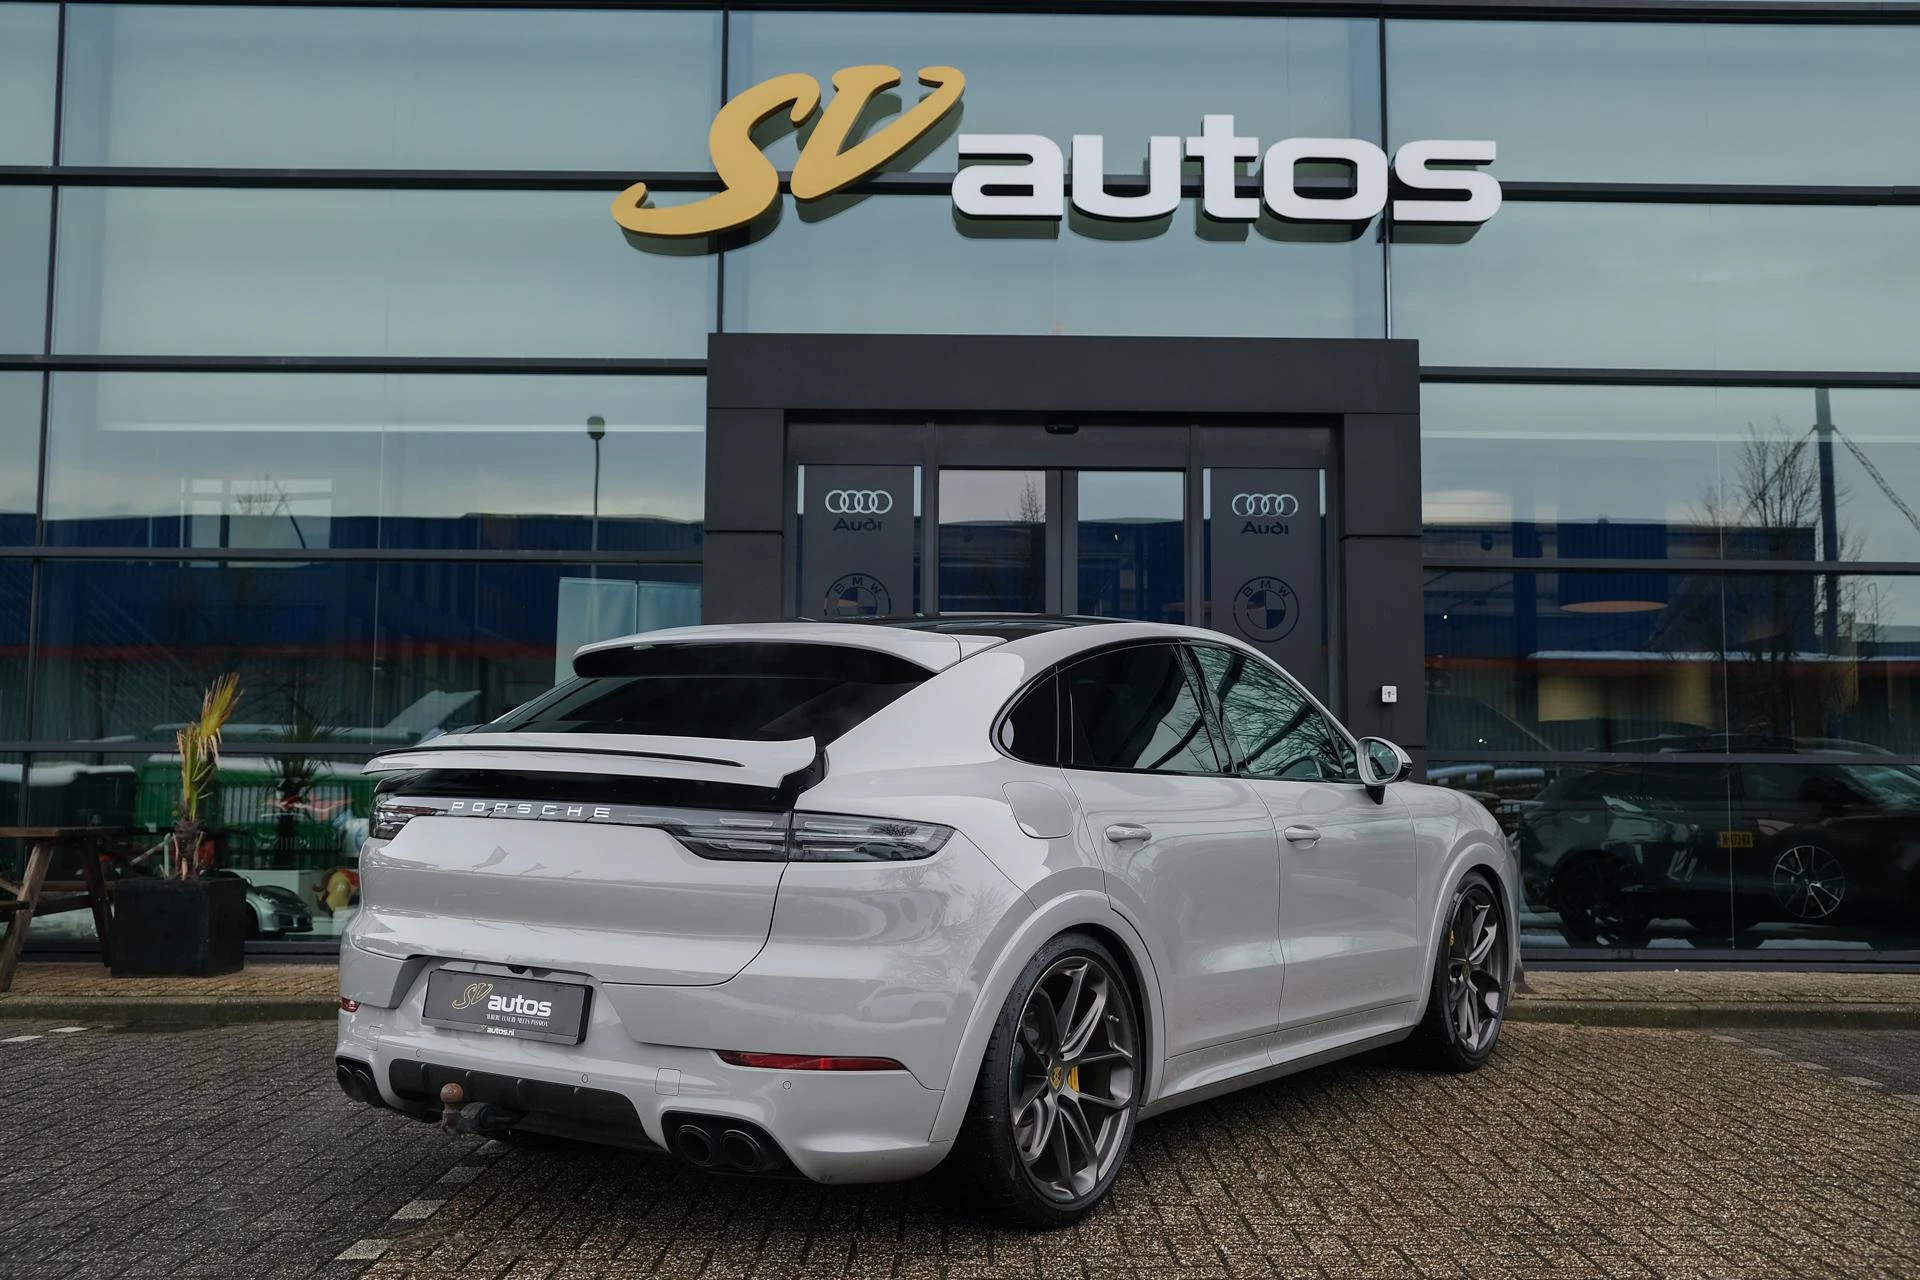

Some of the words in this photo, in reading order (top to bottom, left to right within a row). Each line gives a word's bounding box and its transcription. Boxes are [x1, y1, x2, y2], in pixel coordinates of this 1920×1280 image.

[611, 65, 966, 236] SV
[952, 114, 1502, 221] autos
[832, 517, 882, 531] Audi
[1241, 521, 1289, 535] Audi
[833, 577, 882, 595] BMW
[1242, 580, 1290, 598] BMW
[451, 801, 611, 818] PORSCHE
[452, 982, 494, 1010] SV
[487, 994, 552, 1017] autos
[487, 1026, 515, 1036] autos.nl
